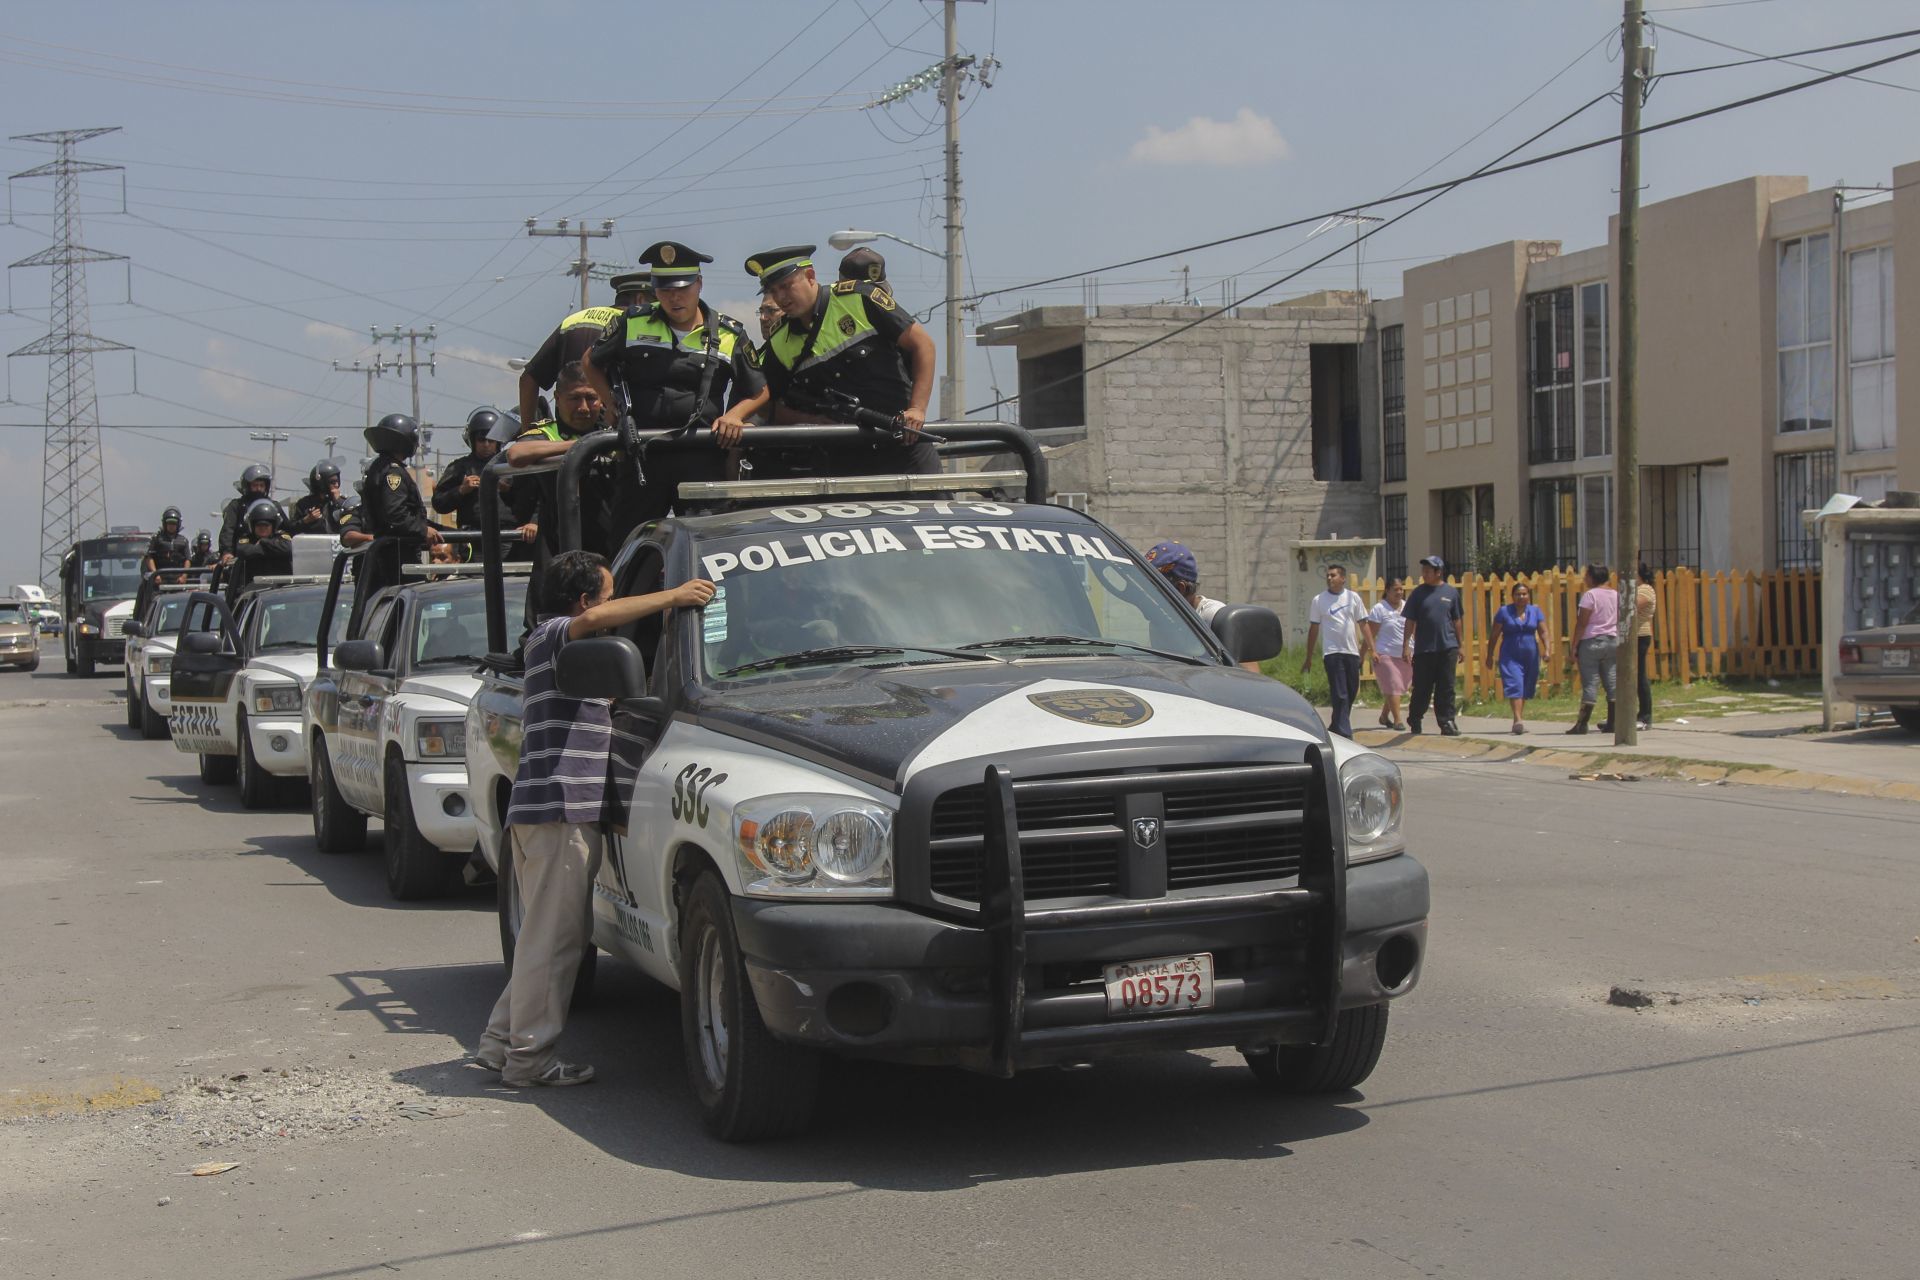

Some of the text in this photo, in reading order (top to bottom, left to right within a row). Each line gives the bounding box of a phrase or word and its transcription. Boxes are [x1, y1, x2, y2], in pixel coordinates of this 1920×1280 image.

[583, 309, 611, 323] POLICIA
[702, 525, 1134, 582] POLICIA ESTATAL
[1051, 695, 1137, 712] SSC
[170, 705, 222, 737] ESTATAL
[672, 763, 728, 829] SSC
[1115, 959, 1202, 979] POLICIA MEX
[1121, 973, 1202, 1008] 08573
